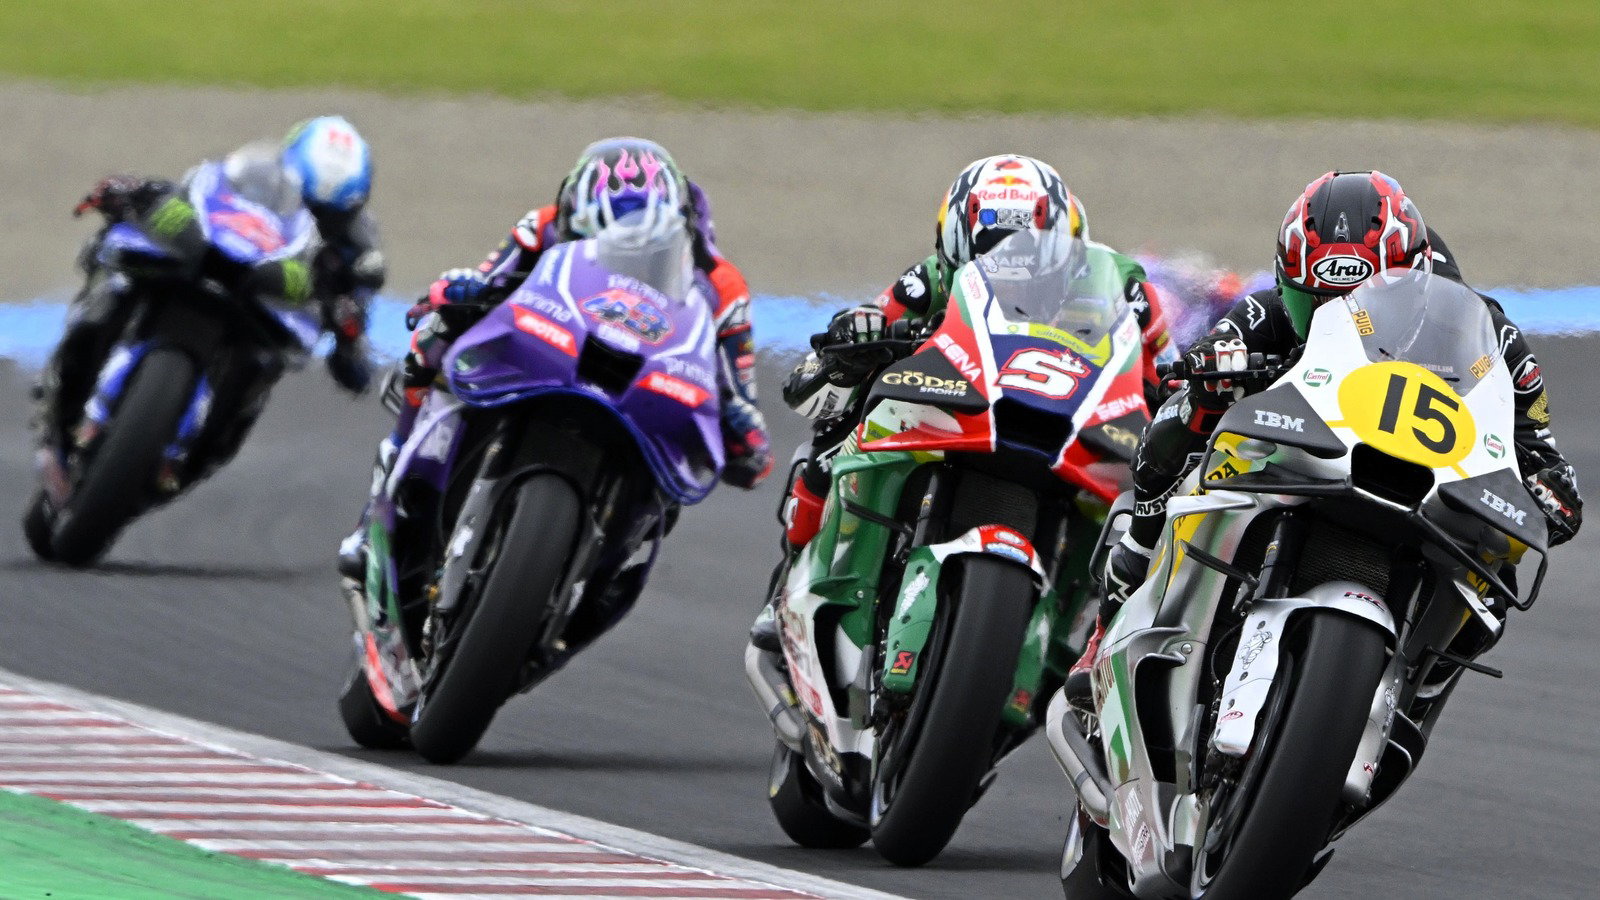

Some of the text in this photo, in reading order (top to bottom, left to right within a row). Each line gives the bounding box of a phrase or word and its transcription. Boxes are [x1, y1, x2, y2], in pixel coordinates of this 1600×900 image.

[978, 188, 1038, 201] Red Bull
[1317, 259, 1366, 277] Arai
[1356, 310, 1373, 334] PUIG
[934, 333, 982, 383] SENA
[1471, 354, 1492, 378] PUIG
[919, 386, 967, 397] SPORTS
[1095, 394, 1145, 421] SENA
[1378, 373, 1459, 454] 15
[1253, 409, 1305, 432] IBM
[1480, 488, 1527, 526] IBM
